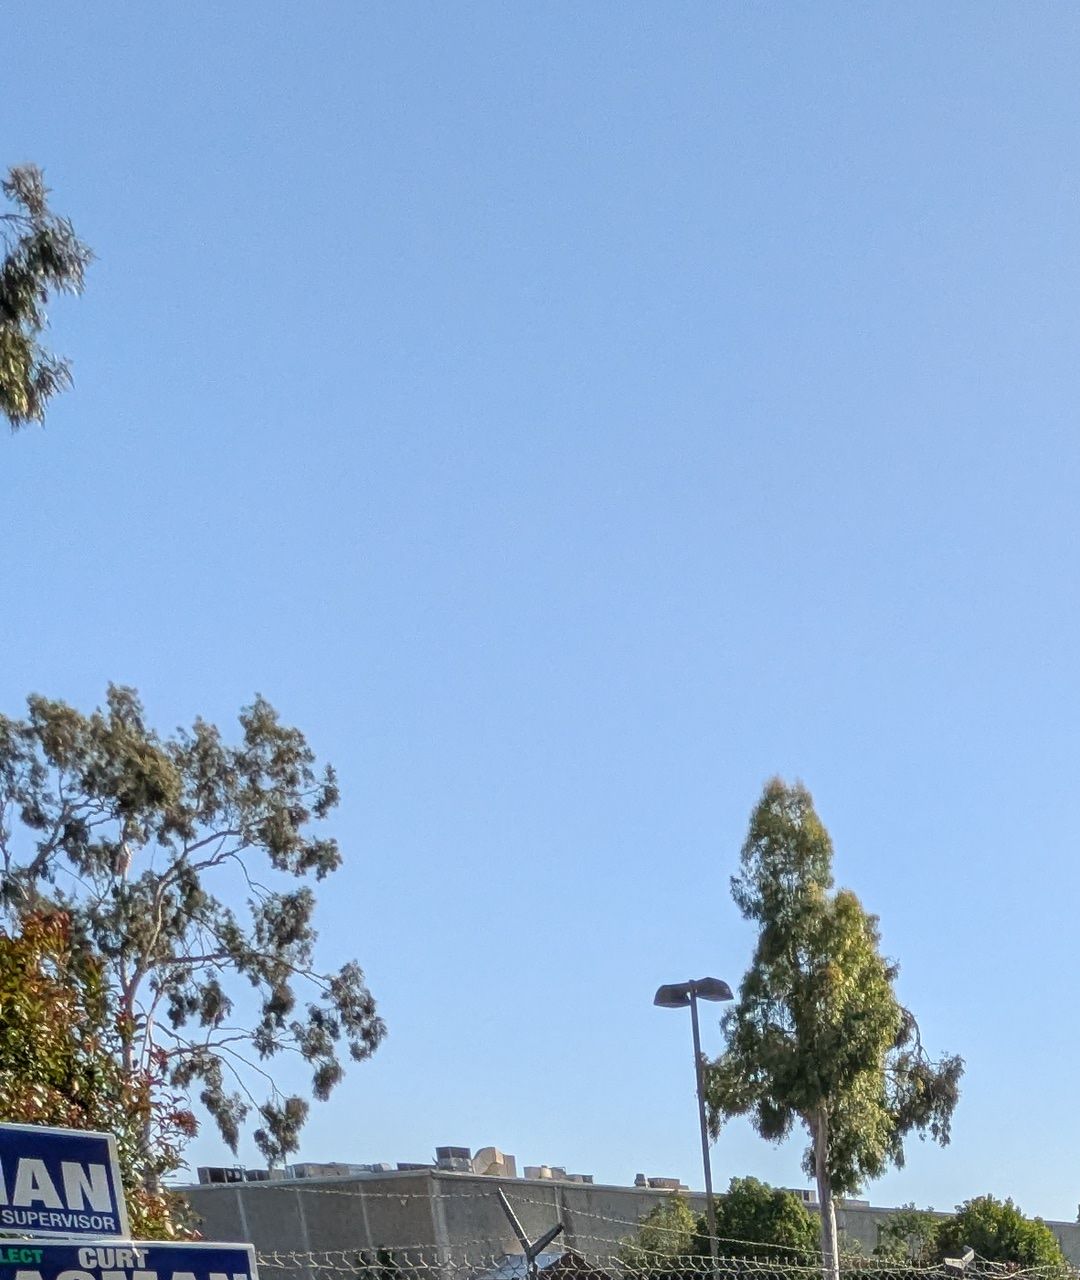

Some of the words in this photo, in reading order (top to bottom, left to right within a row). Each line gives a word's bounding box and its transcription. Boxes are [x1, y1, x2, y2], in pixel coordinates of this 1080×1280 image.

[0, 1157, 113, 1213] AN
[1, 1210, 116, 1231] SUPERVISOR
[78, 1247, 149, 1269] CURT
